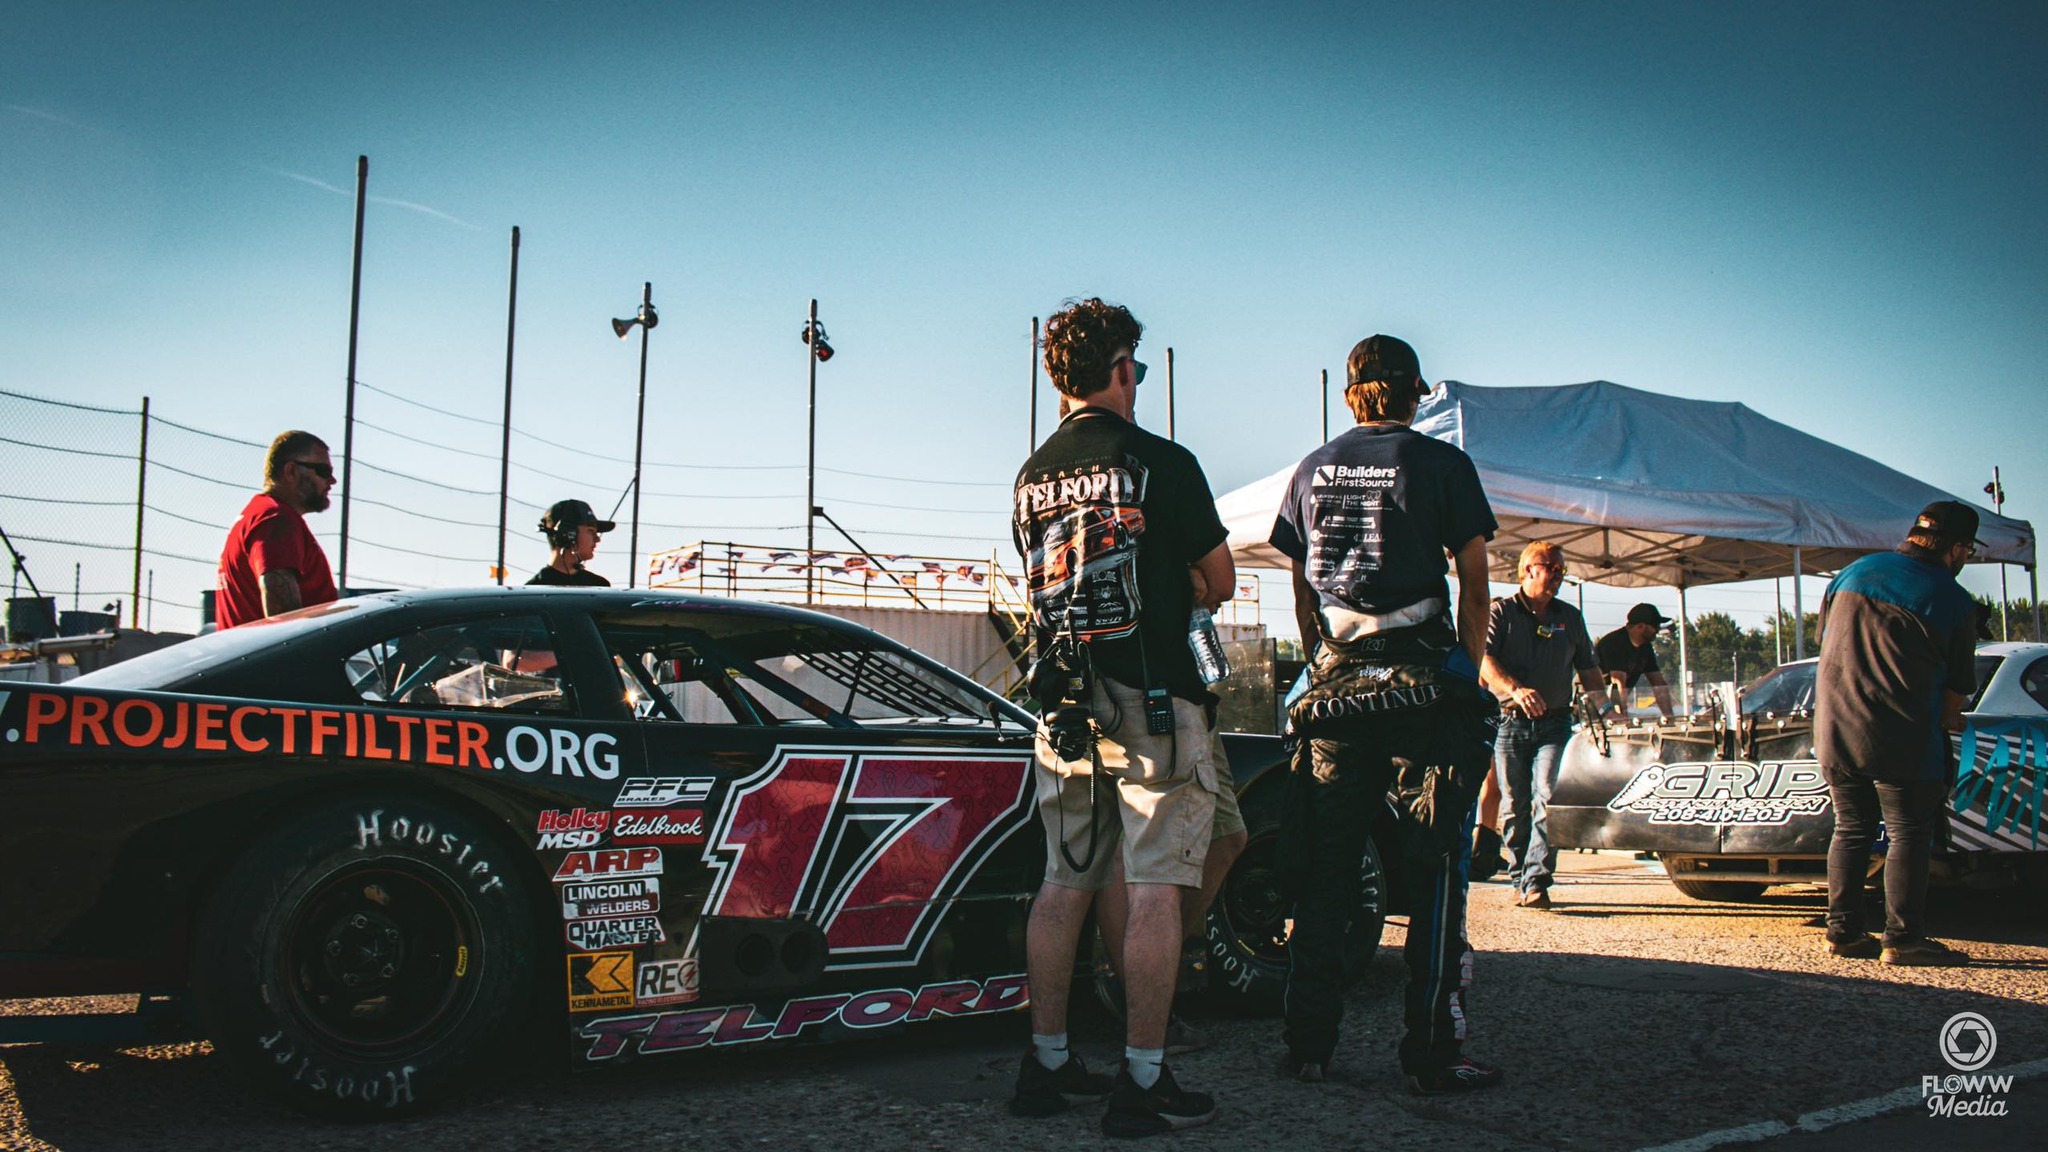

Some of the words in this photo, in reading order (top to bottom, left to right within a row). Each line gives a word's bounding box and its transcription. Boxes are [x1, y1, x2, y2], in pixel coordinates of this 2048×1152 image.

[1042, 464, 1101, 482] ZACH
[1335, 478, 1395, 488] FirstSource
[1336, 465, 1397, 478] Builders
[1017, 467, 1136, 524] TELFORD
[0, 690, 620, 779] .PROJECTFILTER.ORG
[619, 777, 716, 796] PFC
[1655, 762, 1830, 800] GRIP
[537, 807, 611, 833] Holley
[613, 814, 703, 838] Edelbrock
[1653, 807, 1785, 822] 208-410-1203
[352, 809, 504, 894] Hoosier
[536, 830, 601, 851] MSD
[557, 847, 660, 876] ARP
[703, 746, 1036, 970] 17
[568, 882, 642, 901] LINCOLN
[586, 899, 651, 915] WELDERS
[568, 917, 657, 942] QUARTER
[585, 929, 662, 949] MASTER
[571, 996, 632, 1009] KENNAMETAL
[579, 973, 1031, 1061] TELFORD
[259, 1030, 418, 1108] Hoosier
